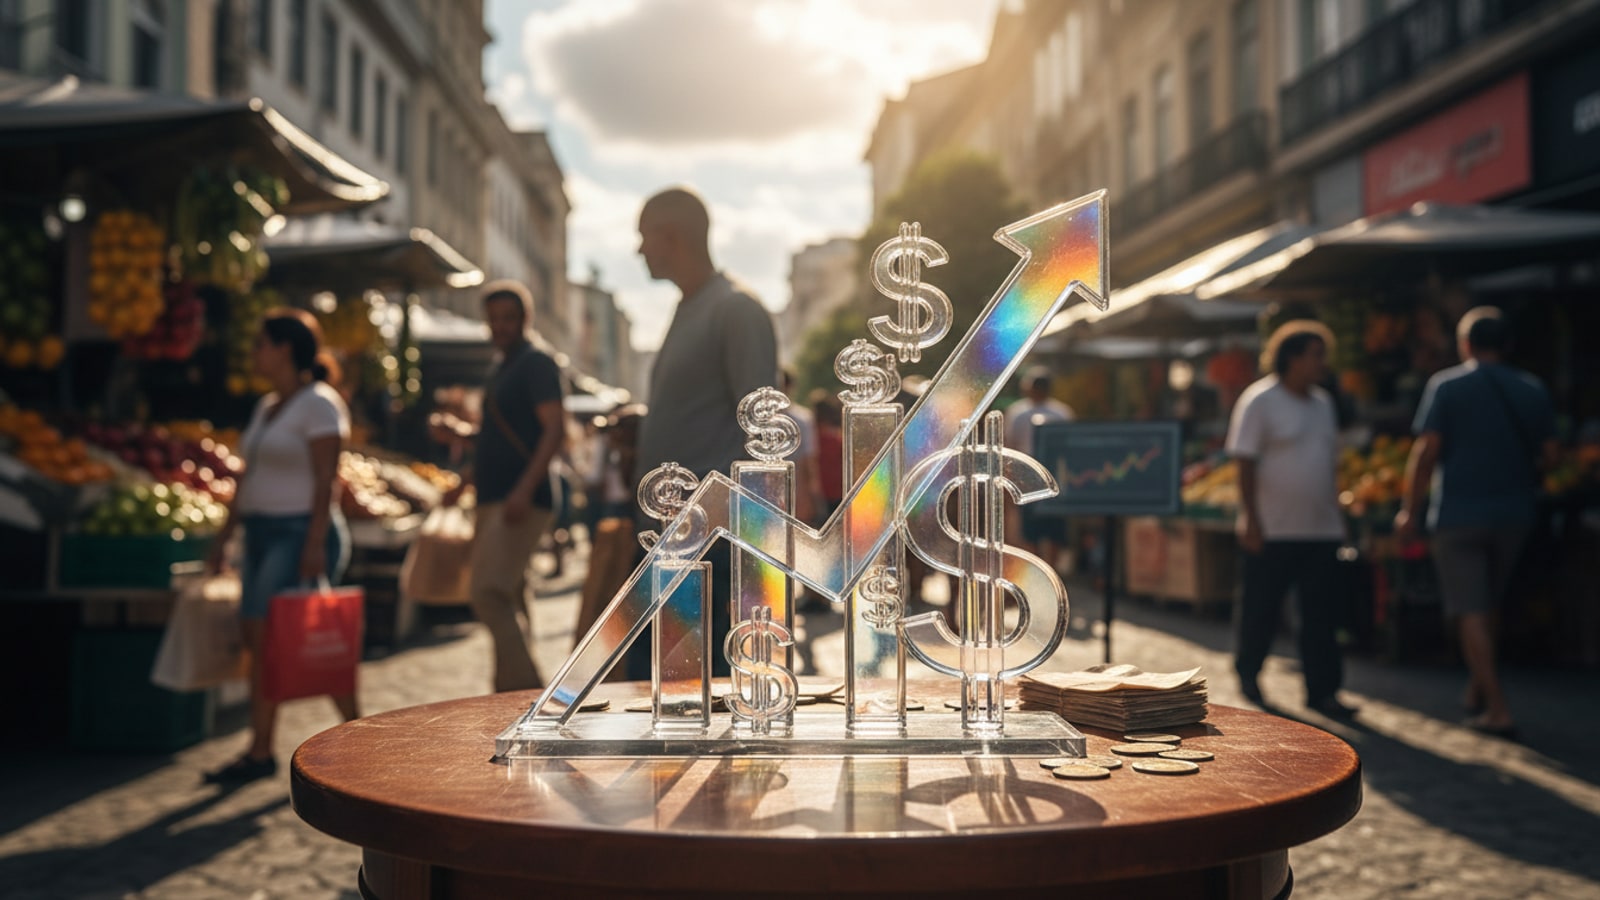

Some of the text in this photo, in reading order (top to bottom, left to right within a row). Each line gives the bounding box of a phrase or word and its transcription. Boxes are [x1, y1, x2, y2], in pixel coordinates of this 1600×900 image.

[867, 221, 954, 363] $
[737, 386, 801, 462] $
[901, 410, 1070, 729] $
[723, 606, 799, 735] $
